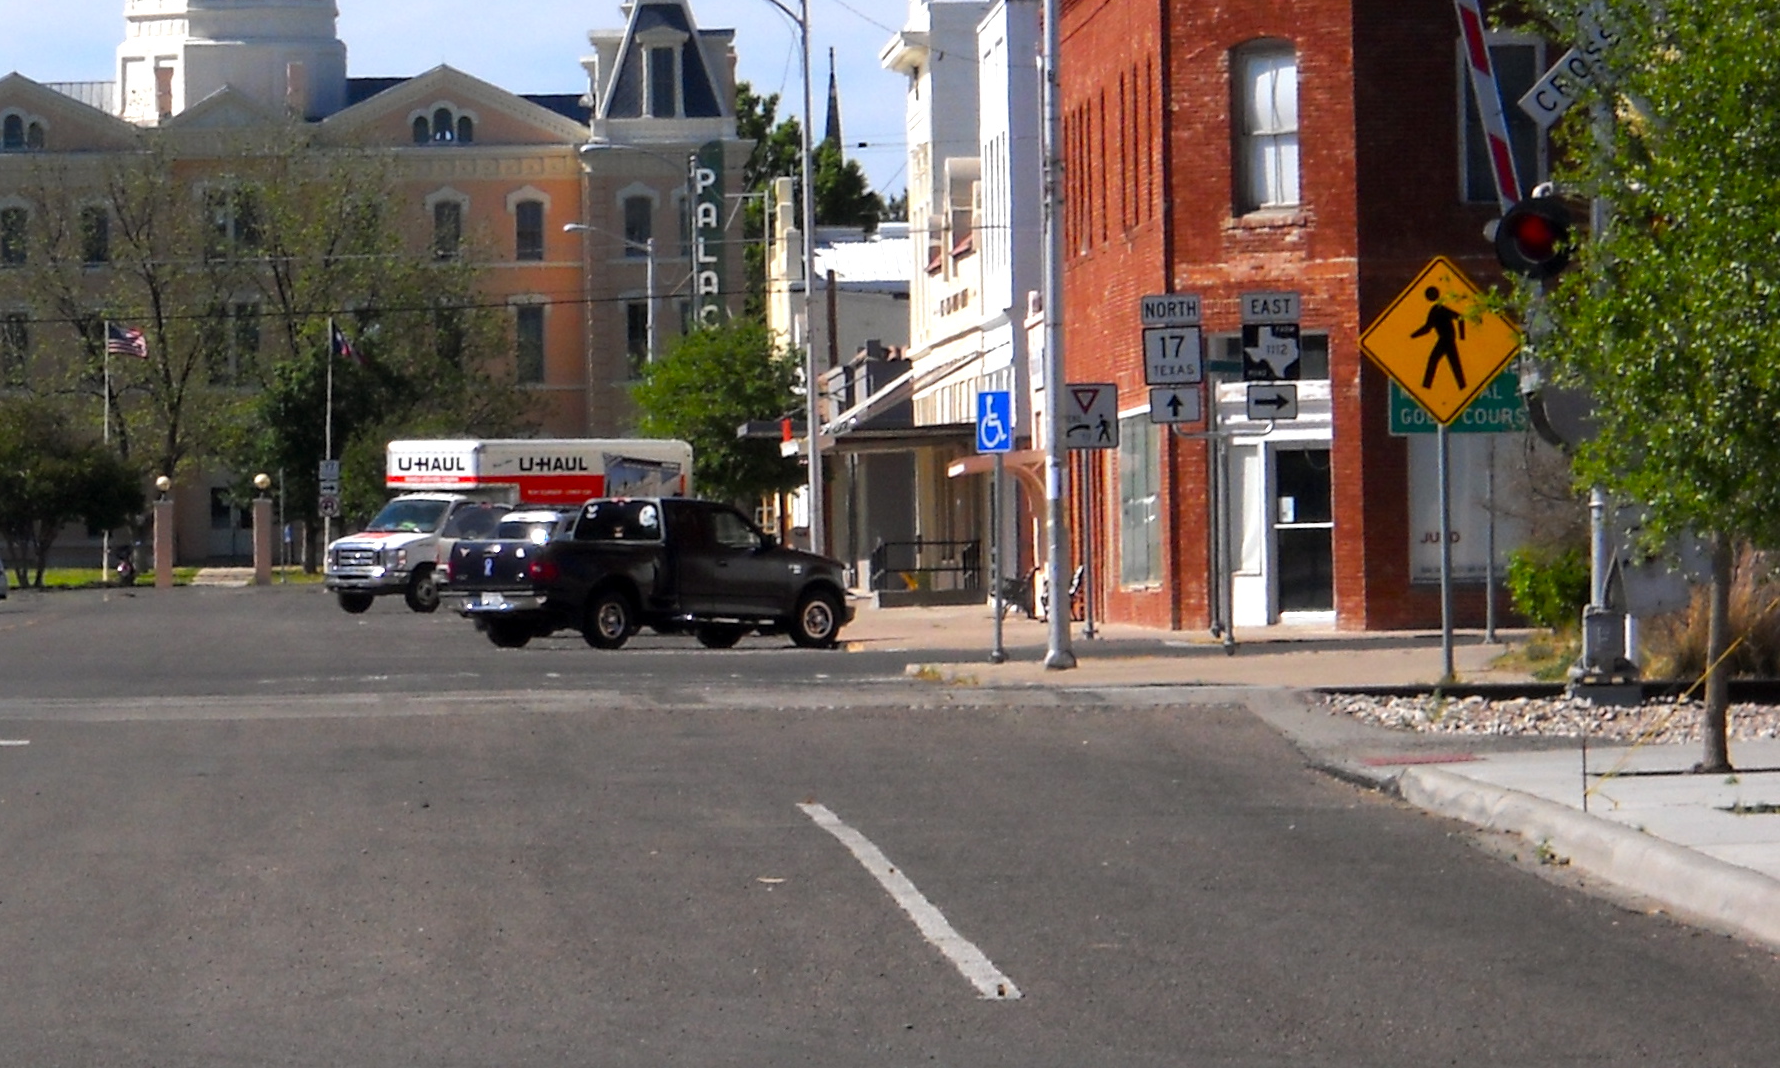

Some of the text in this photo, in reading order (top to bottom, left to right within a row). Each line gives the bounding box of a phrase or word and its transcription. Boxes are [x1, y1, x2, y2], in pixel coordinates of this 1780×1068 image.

[696, 168, 719, 330] PALAC
[1145, 301, 1197, 318] NORTH
[1251, 298, 1291, 315] EAST
[1160, 335, 1185, 359] 17
[1266, 343, 1288, 356] 1112
[1153, 364, 1195, 376] TEXAS
[1463, 408, 1527, 425] COURS
[398, 456, 466, 471] U-HAUL
[519, 457, 588, 471] U-HAUL
[1420, 531, 1461, 544] JUD
